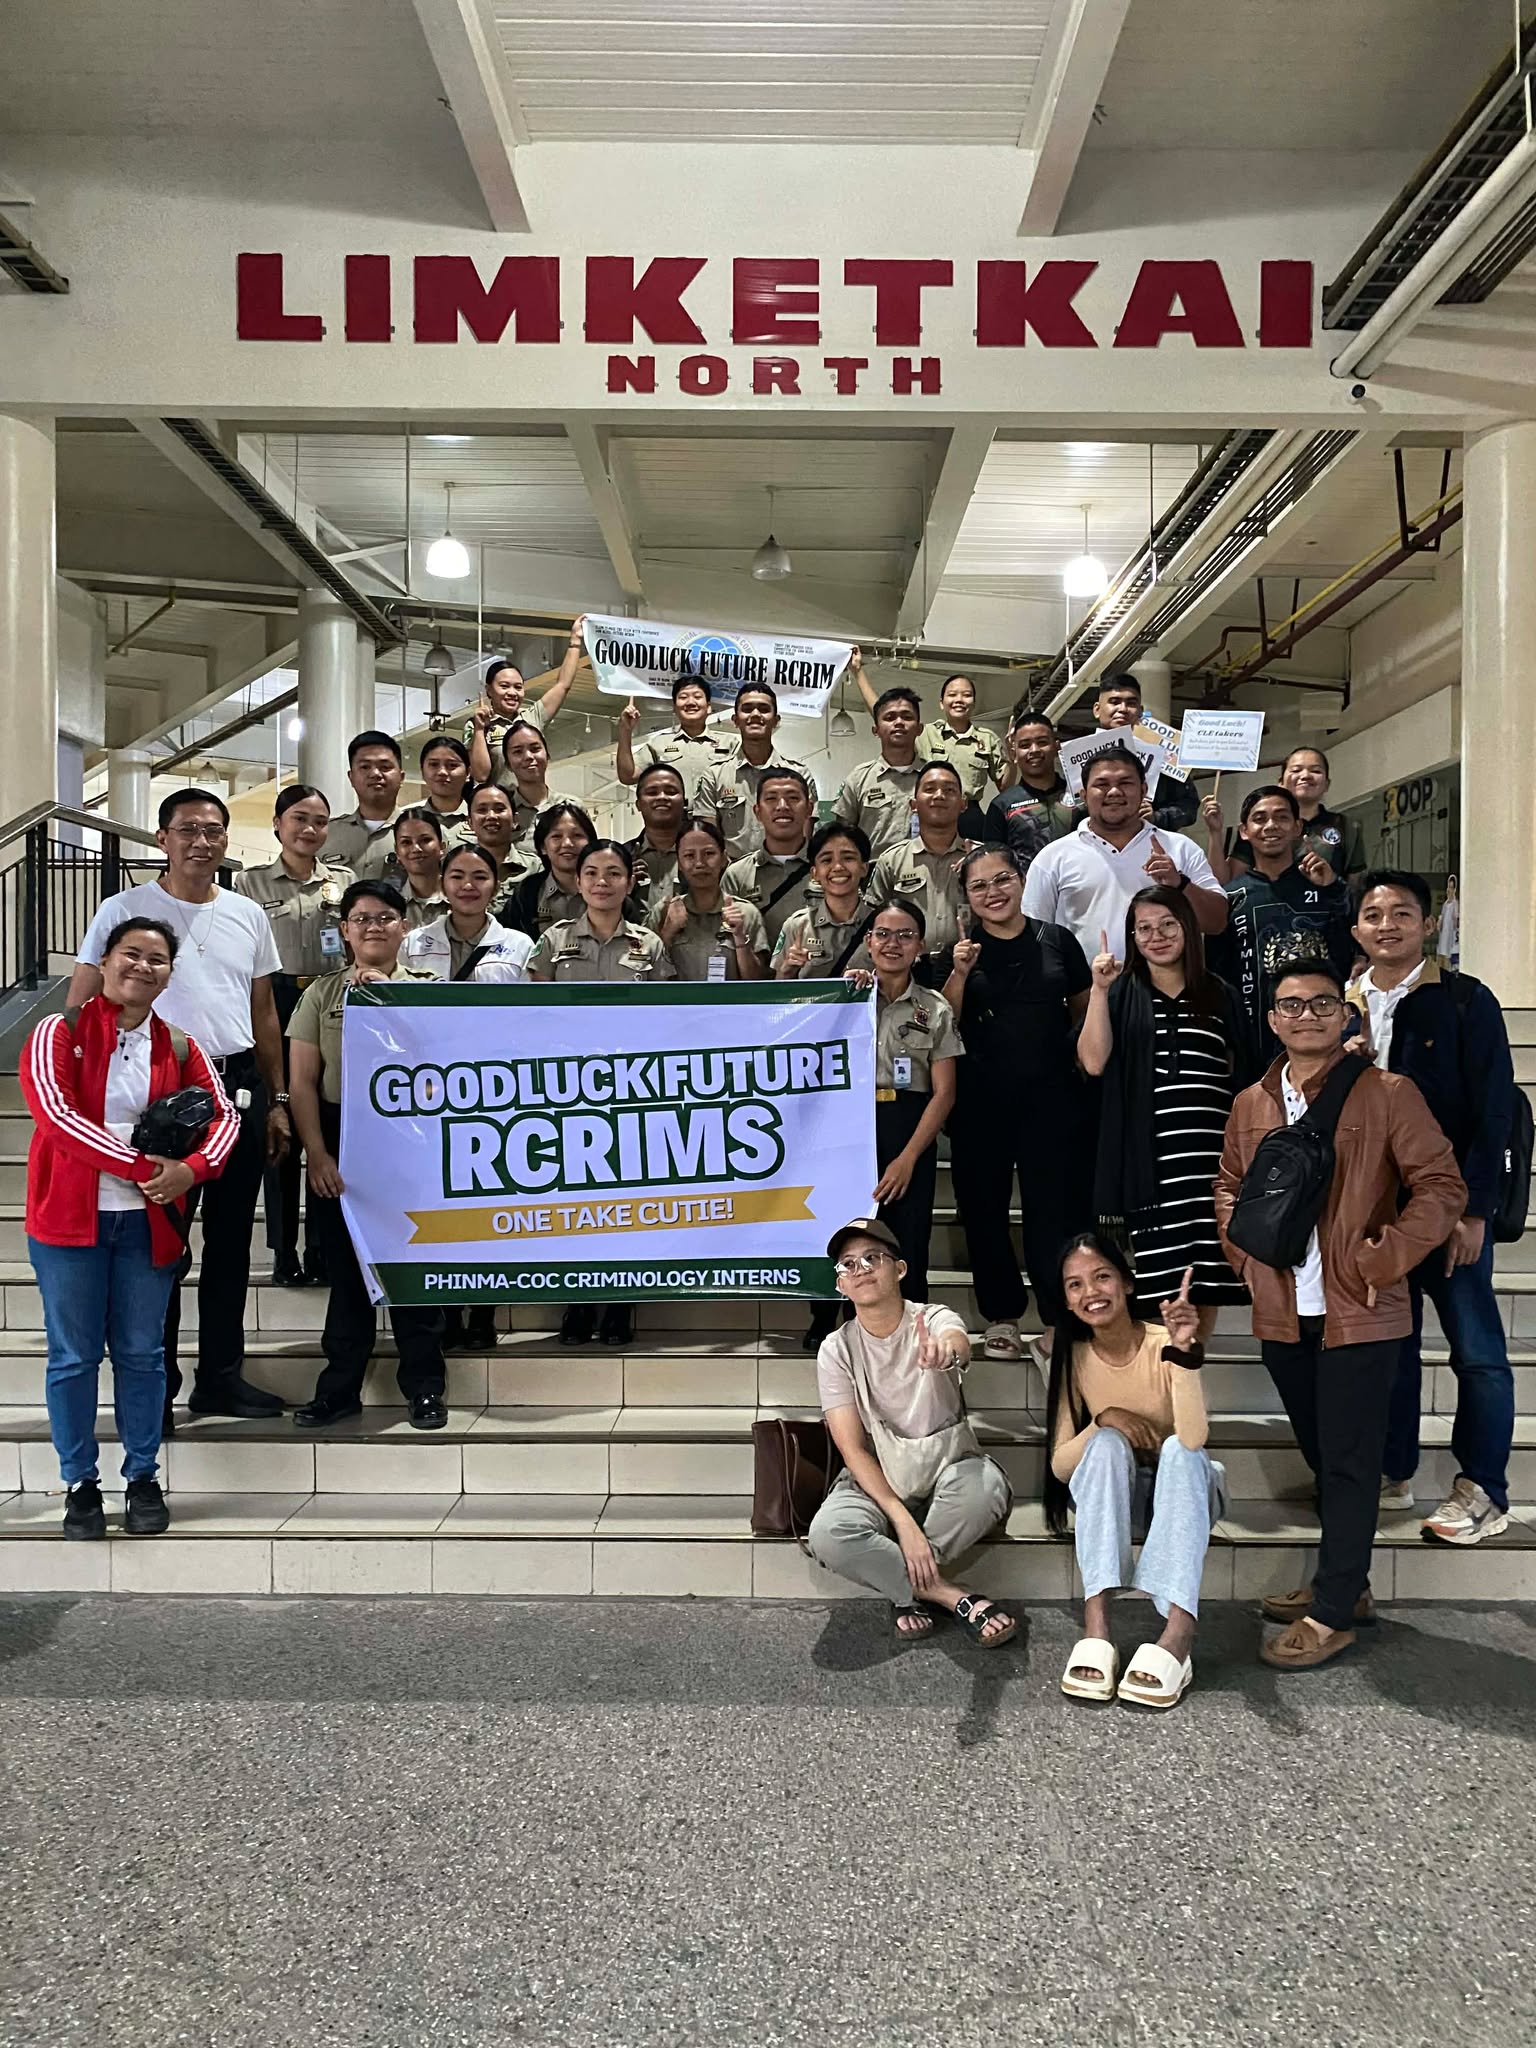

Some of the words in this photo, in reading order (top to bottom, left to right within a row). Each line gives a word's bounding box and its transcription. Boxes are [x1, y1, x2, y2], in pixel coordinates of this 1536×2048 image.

[237, 253, 1314, 348] LIMKETKAI
[607, 356, 942, 395] NORTH
[595, 638, 692, 674] GOODLUCK
[699, 651, 769, 683] FUTURE
[773, 658, 836, 690] RCRIM
[1141, 717, 1176, 739] GOOD
[1070, 749, 1094, 765] GOOD
[1159, 738, 1180, 755] LU
[1304, 890, 1318, 903] 21
[443, 1102, 784, 1197] RCRIMS
[492, 1208, 552, 1235] ONE
[557, 1204, 633, 1230] TAKE
[638, 1198, 735, 1225] CUTIE!
[424, 1271, 560, 1290] PHINMA-COC
[564, 1270, 709, 1288] CRIMINOLOGY
[711, 1268, 801, 1287] INTERNS
